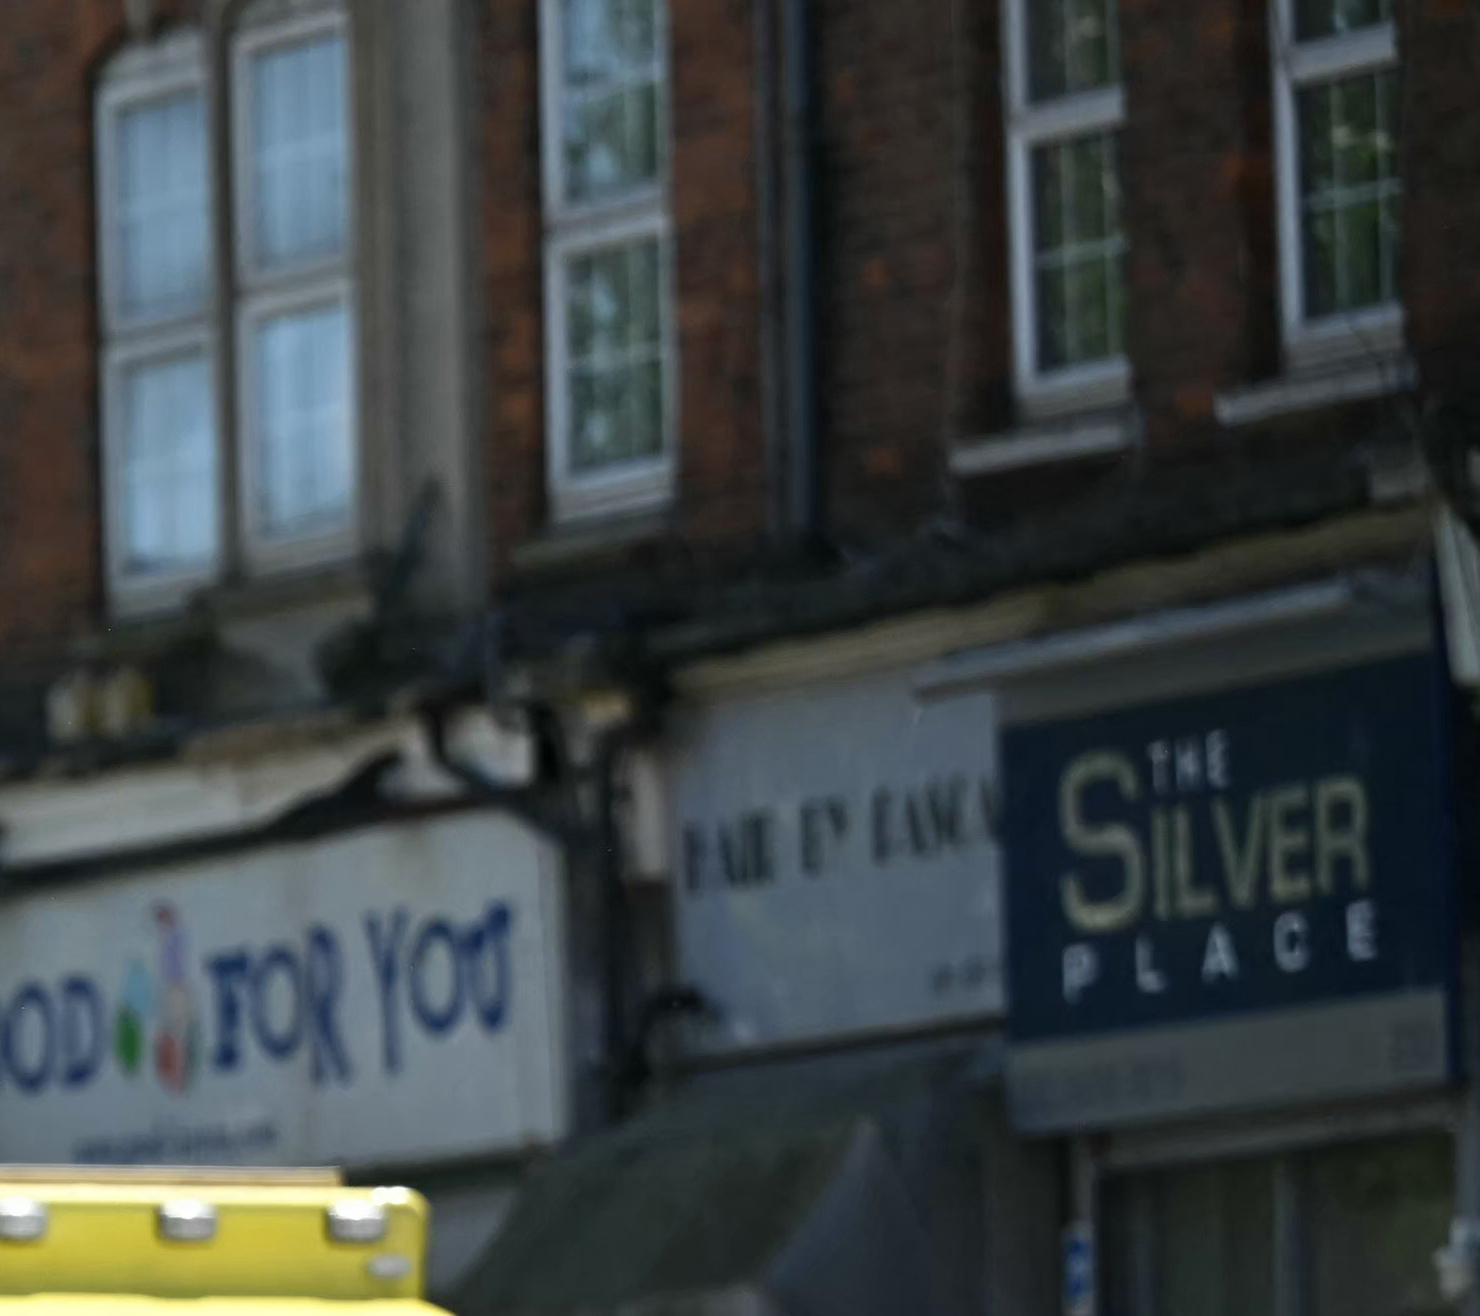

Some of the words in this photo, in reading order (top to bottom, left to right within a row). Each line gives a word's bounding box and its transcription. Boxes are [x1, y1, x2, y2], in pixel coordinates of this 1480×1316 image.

[1148, 728, 1231, 792] THE
[1060, 748, 1371, 936] SILVER
[206, 921, 353, 1087] FOR
[366, 901, 513, 1078] YOU
[1062, 899, 1380, 1004] PLACE
